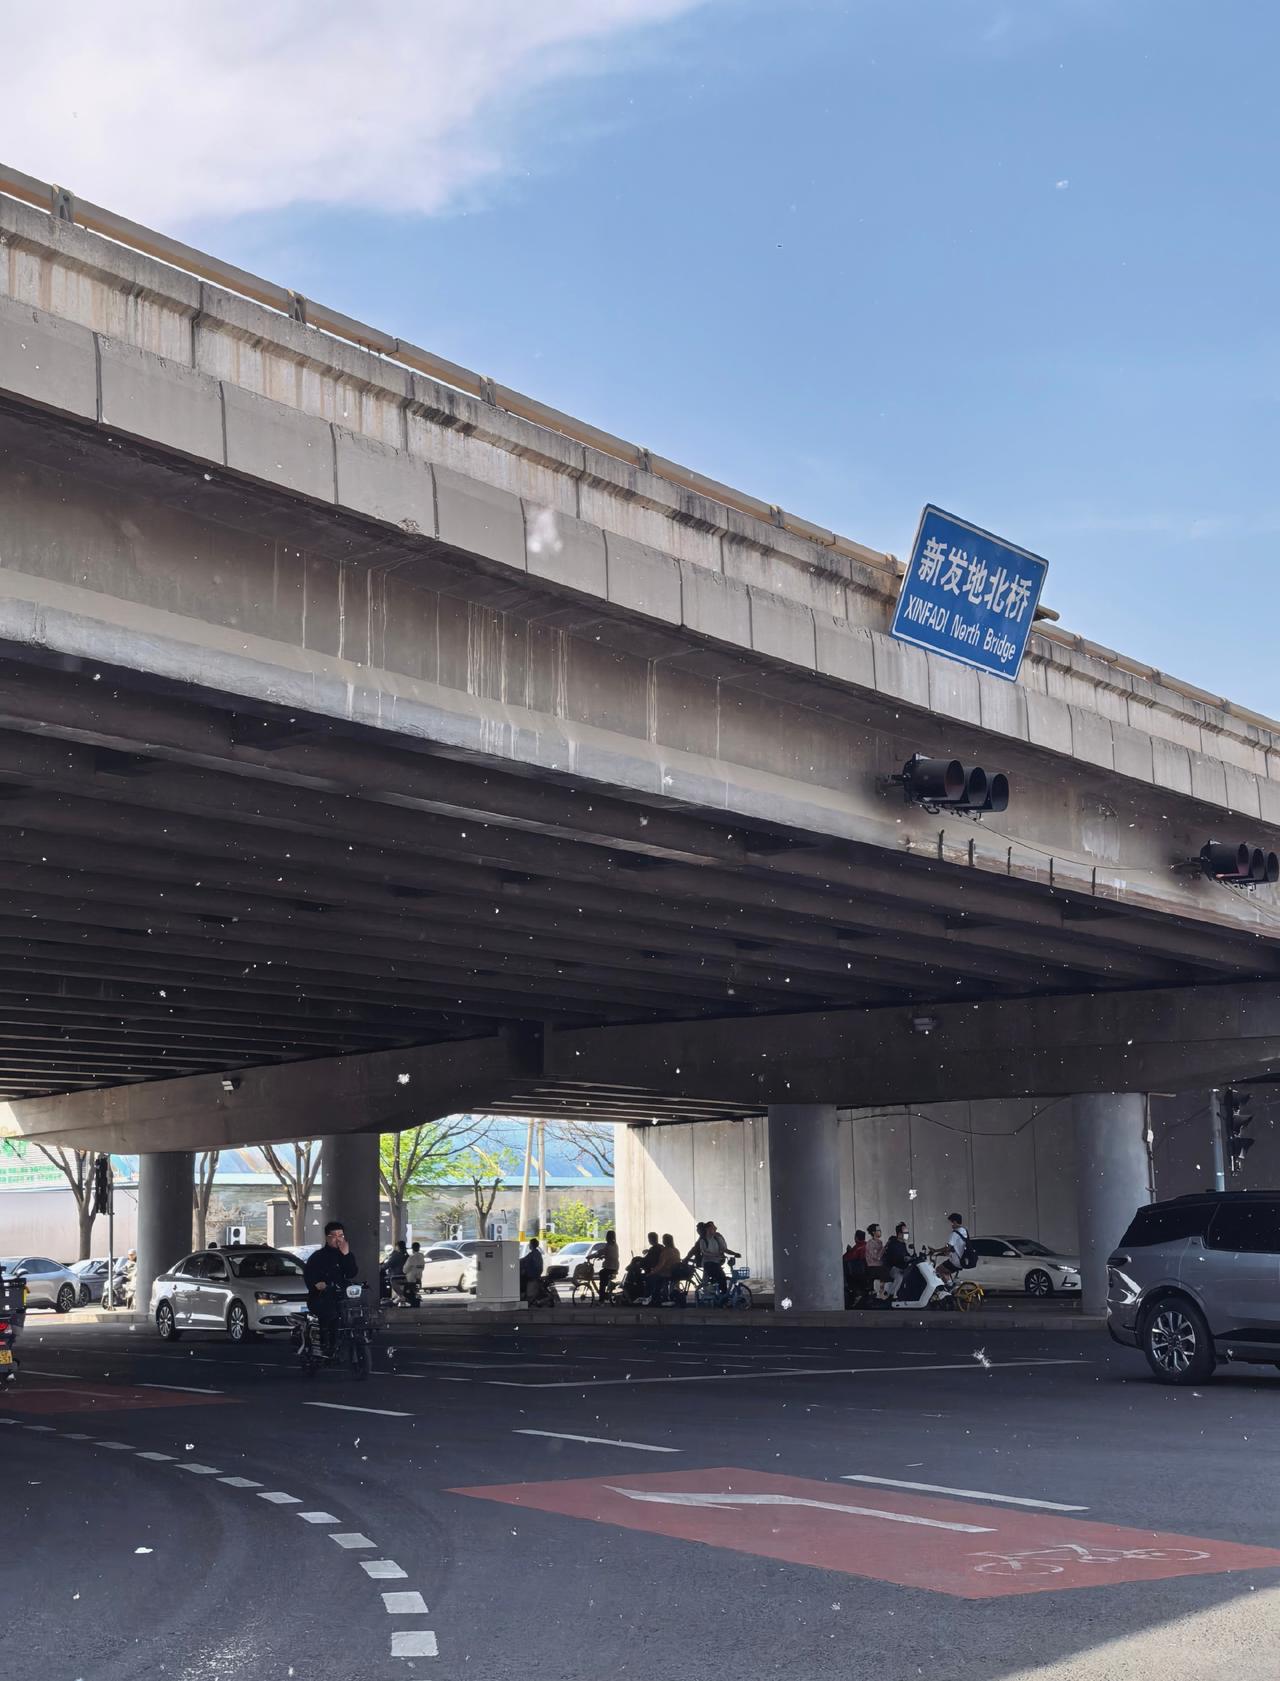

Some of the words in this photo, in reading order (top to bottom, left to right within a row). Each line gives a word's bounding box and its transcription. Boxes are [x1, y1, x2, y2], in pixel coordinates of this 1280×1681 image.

[917, 536, 1032, 622] 新发地北桥
[904, 594, 950, 633] XINFADI
[950, 614, 980, 646] North
[983, 627, 1016, 663] Bridge
